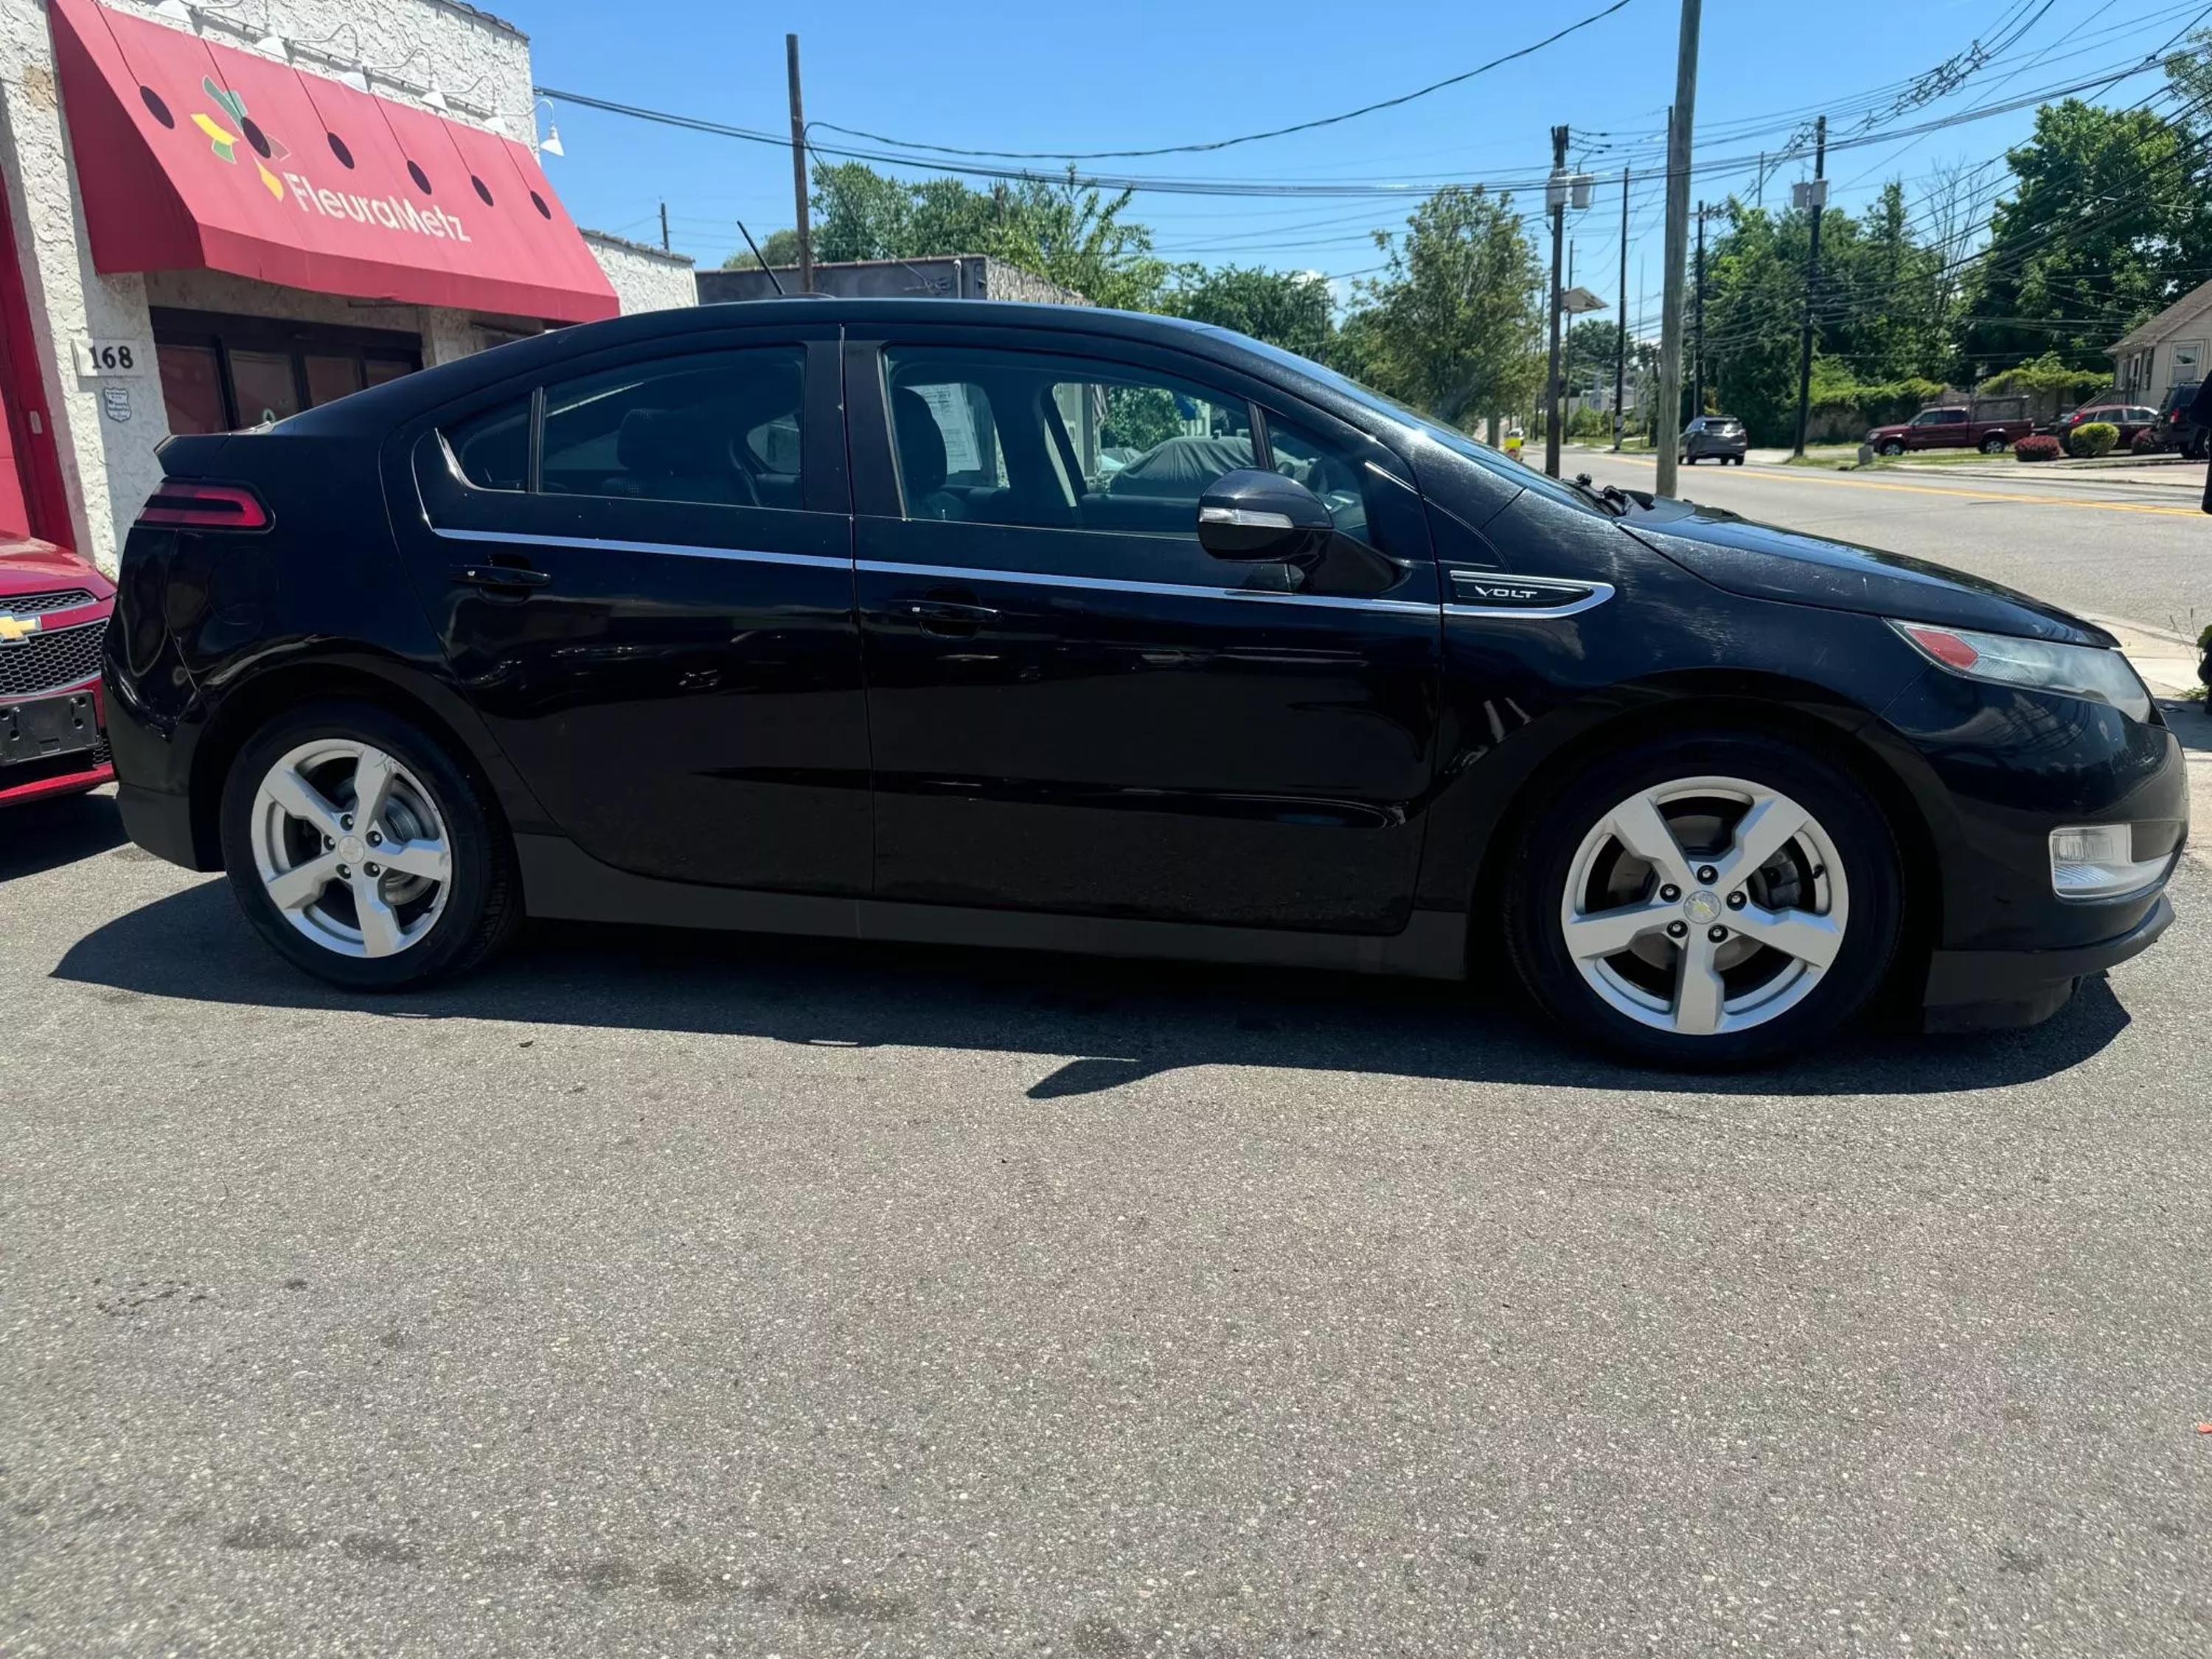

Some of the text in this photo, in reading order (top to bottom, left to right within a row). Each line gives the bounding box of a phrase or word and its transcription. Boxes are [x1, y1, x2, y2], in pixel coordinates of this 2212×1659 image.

[283, 173, 472, 243] FleuraMetz
[89, 346, 133, 369] 168
[1475, 585, 1537, 599] VOLT
